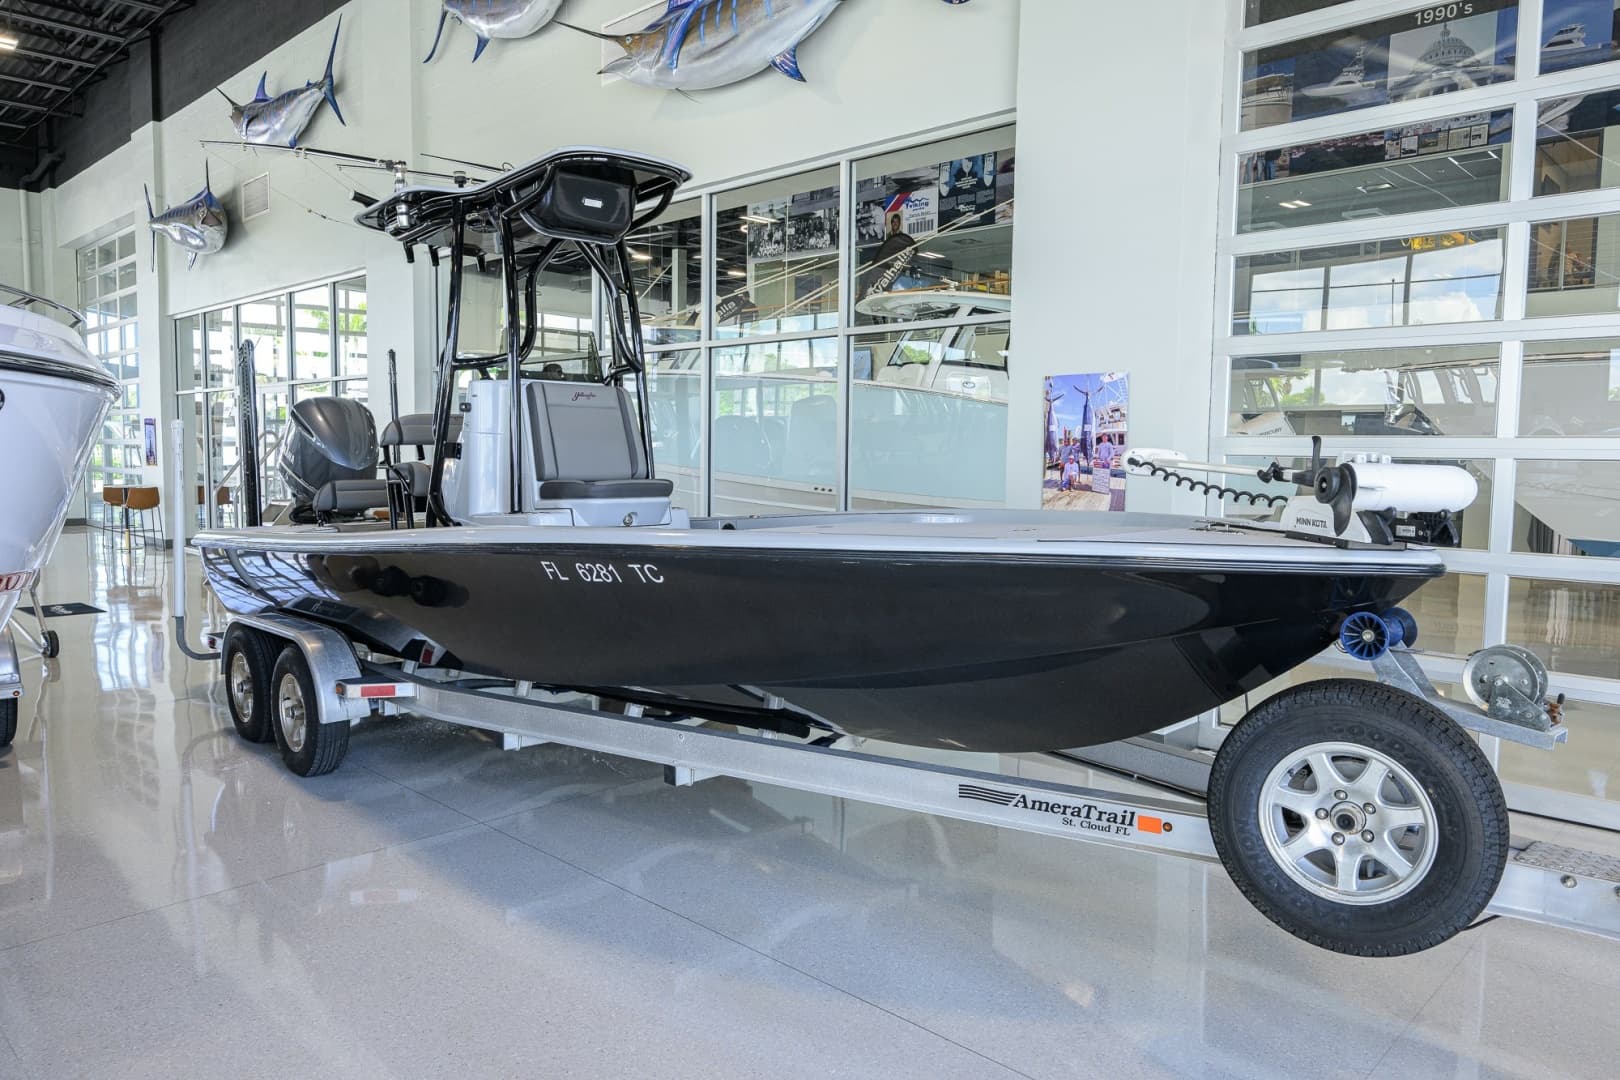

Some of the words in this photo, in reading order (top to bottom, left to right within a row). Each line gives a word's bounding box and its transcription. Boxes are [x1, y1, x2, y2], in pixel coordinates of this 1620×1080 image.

[1415, 2, 1473, 25] 1990's
[541, 561, 570, 580] FL
[575, 563, 623, 583] 6281
[628, 564, 665, 583] TC
[1013, 794, 1136, 826] AmeraTrail
[1062, 817, 1076, 827] St.
[1080, 820, 1111, 832] Cloud
[1115, 826, 1130, 836] FL
